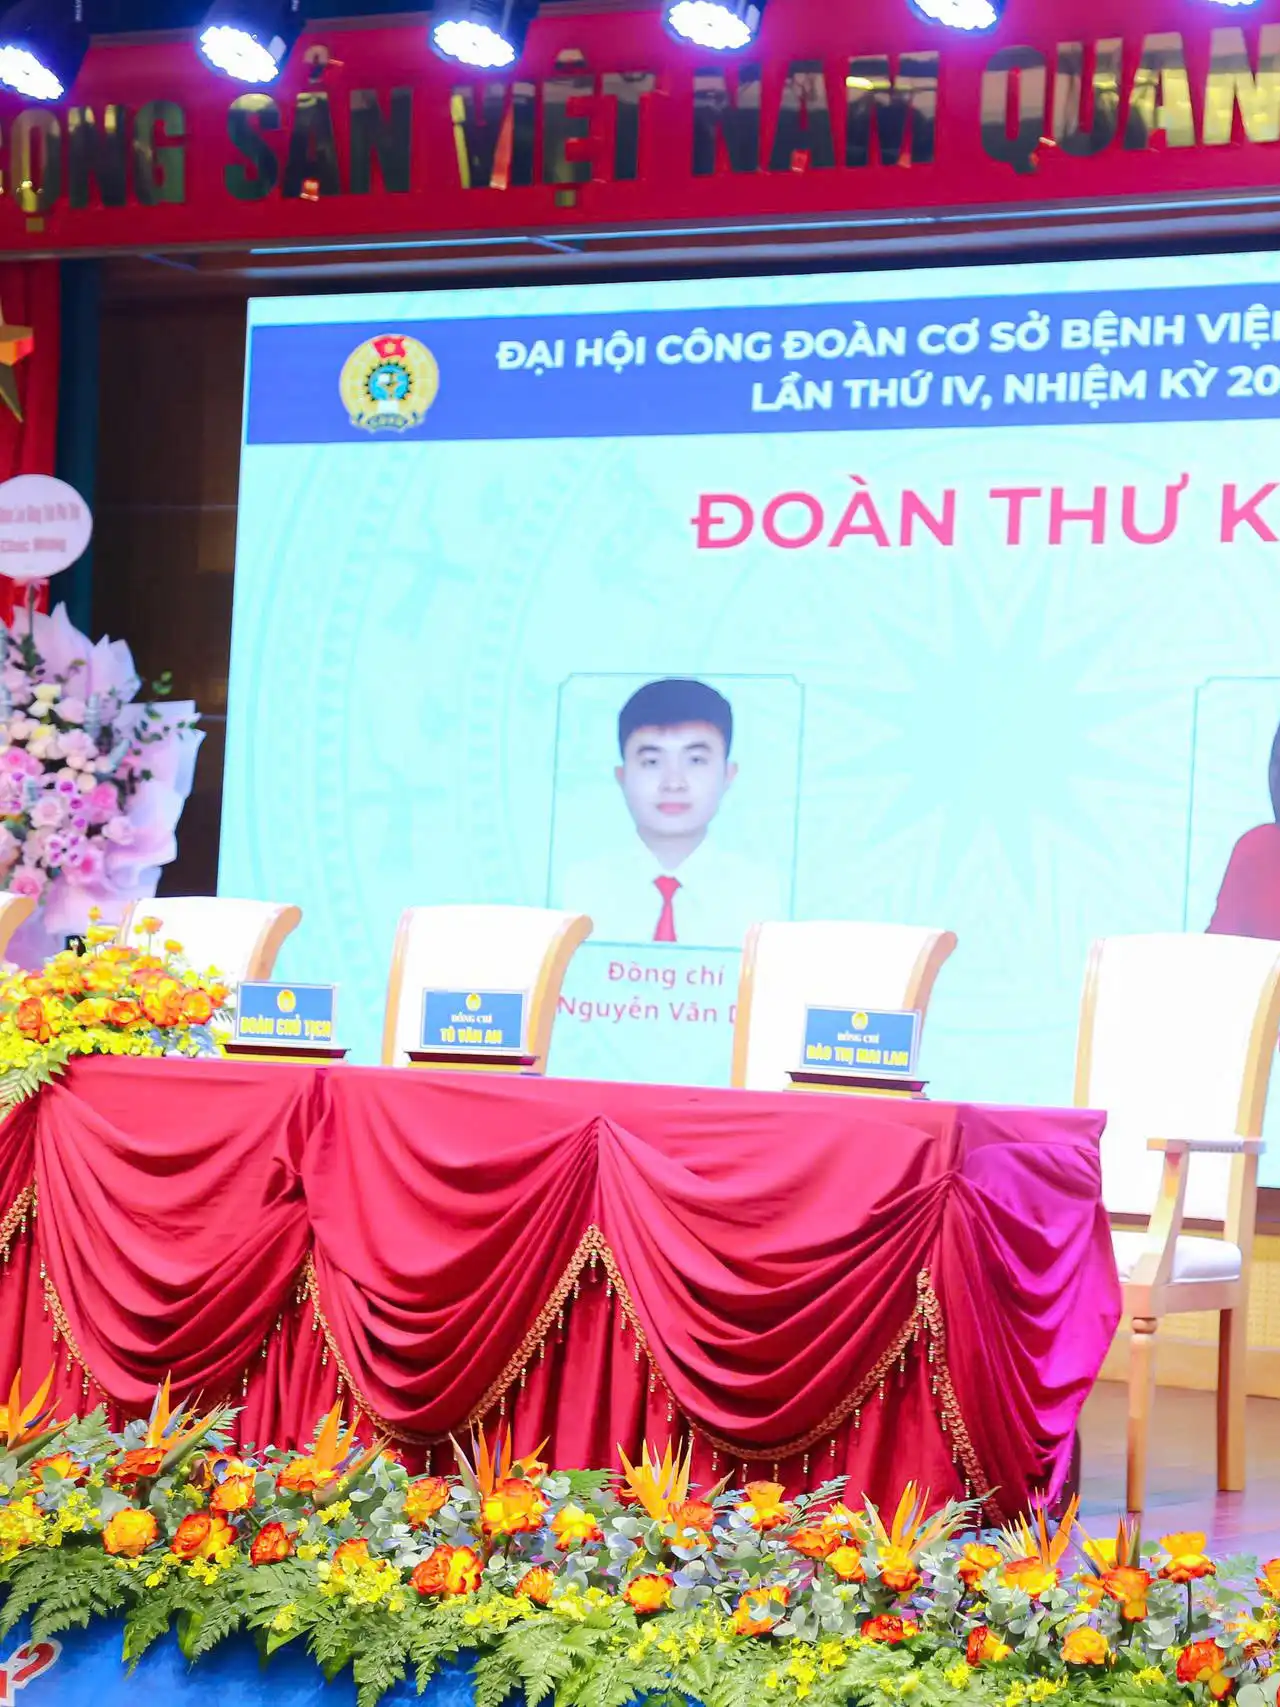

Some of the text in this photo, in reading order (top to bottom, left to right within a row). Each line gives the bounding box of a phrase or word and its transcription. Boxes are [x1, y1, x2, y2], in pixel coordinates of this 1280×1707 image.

[223, 45, 413, 202] SẢN
[450, 48, 657, 208] VIỆT
[692, 50, 939, 176] NAM
[496, 339, 564, 374] ĐẠI
[576, 330, 646, 373] HỘI
[656, 327, 772, 364] CÔNG
[781, 320, 906, 360] ĐOÀN
[917, 317, 980, 354] CƠ
[989, 310, 1050, 352] SỞ
[1061, 310, 1185, 355] BỆNH
[752, 369, 833, 411] LẦN
[843, 369, 933, 408] THỨ
[942, 375, 992, 410] IV,
[1004, 363, 1147, 409] NHIỆM
[1160, 359, 1218, 399] KỲ
[690, 474, 956, 550] ĐOÀN
[989, 472, 1190, 546] THƯ
[686, 964, 726, 986] chí
